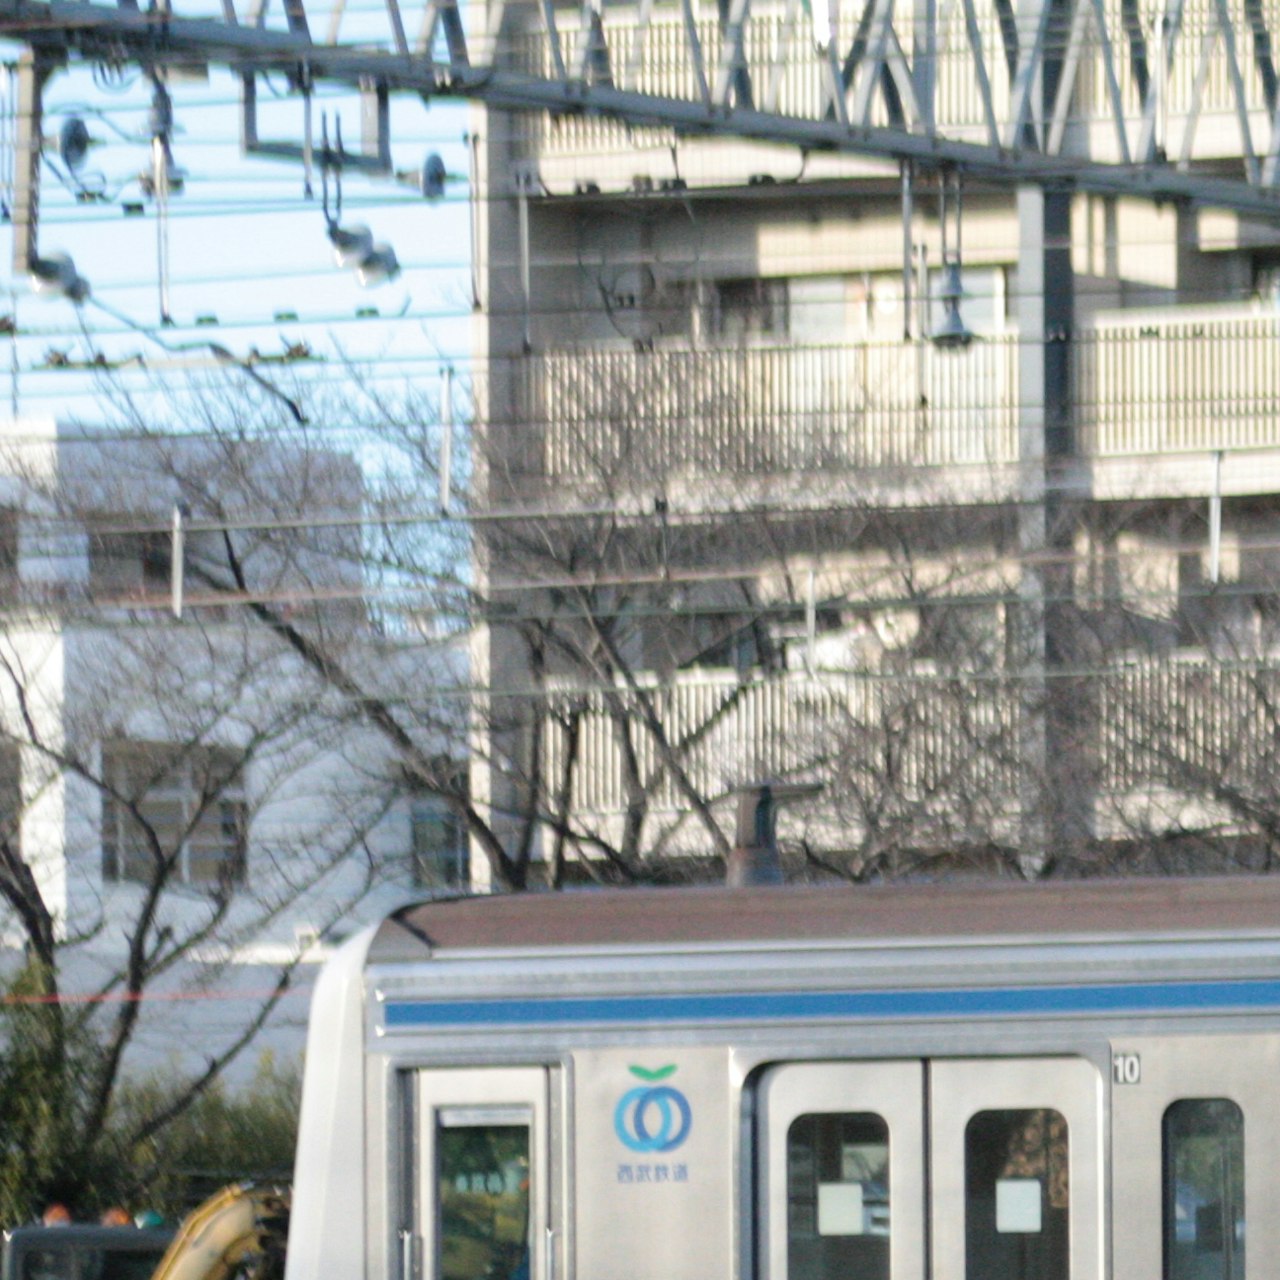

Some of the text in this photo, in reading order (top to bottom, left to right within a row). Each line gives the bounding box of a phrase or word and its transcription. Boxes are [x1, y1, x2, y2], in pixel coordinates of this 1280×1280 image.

[1114, 1056, 1139, 1083] 10
[618, 1163, 688, 1183] 西武鉄道
